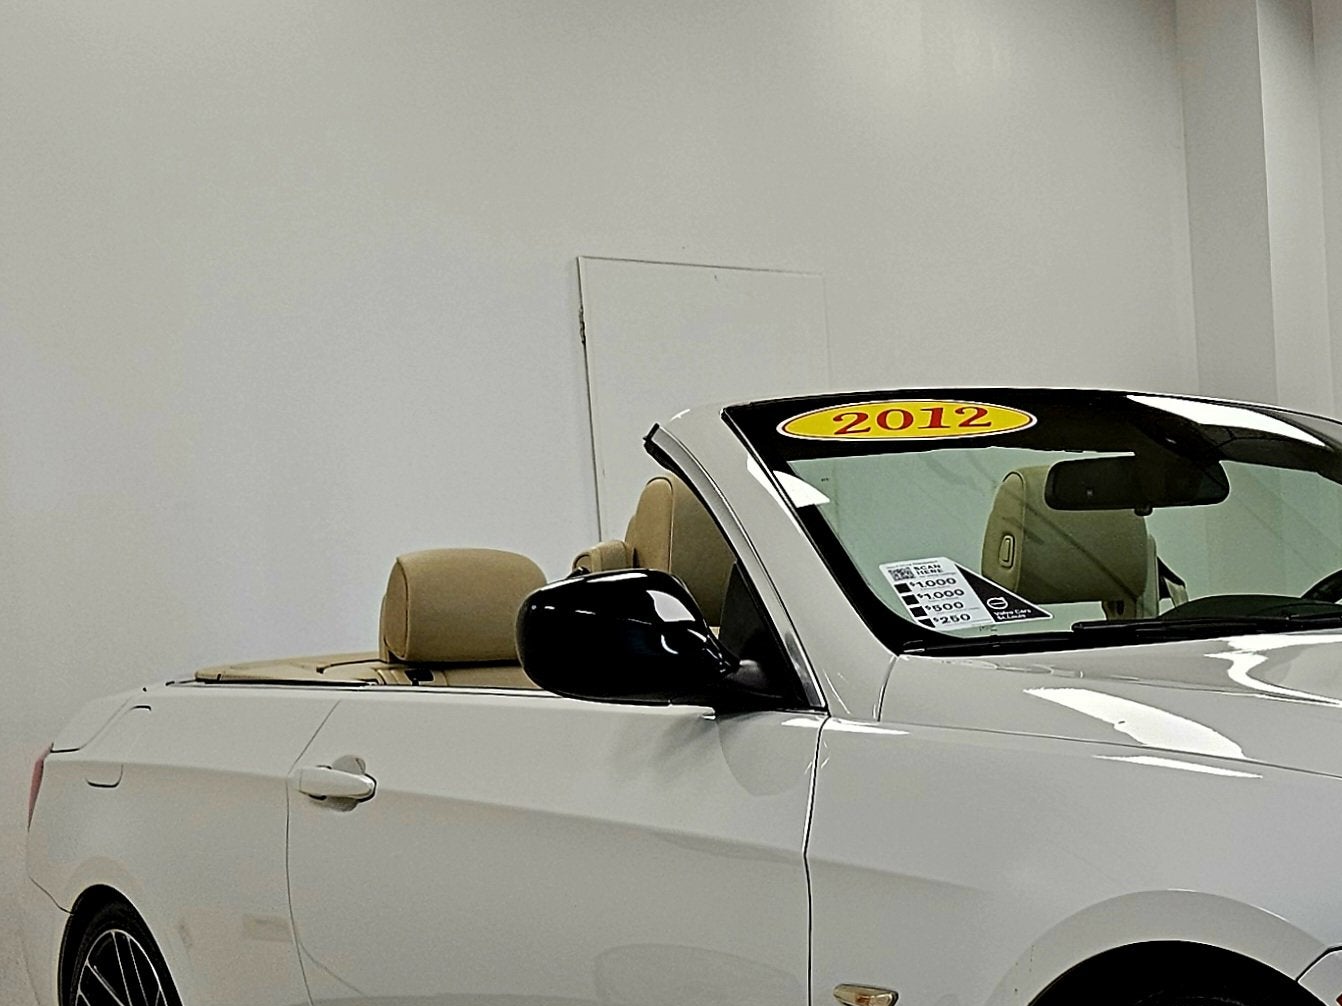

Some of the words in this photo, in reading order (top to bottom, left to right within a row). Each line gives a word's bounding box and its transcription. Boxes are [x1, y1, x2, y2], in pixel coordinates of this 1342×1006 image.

[832, 406, 992, 435] 2012
[925, 601, 964, 612] $500
[933, 613, 971, 624] $250
